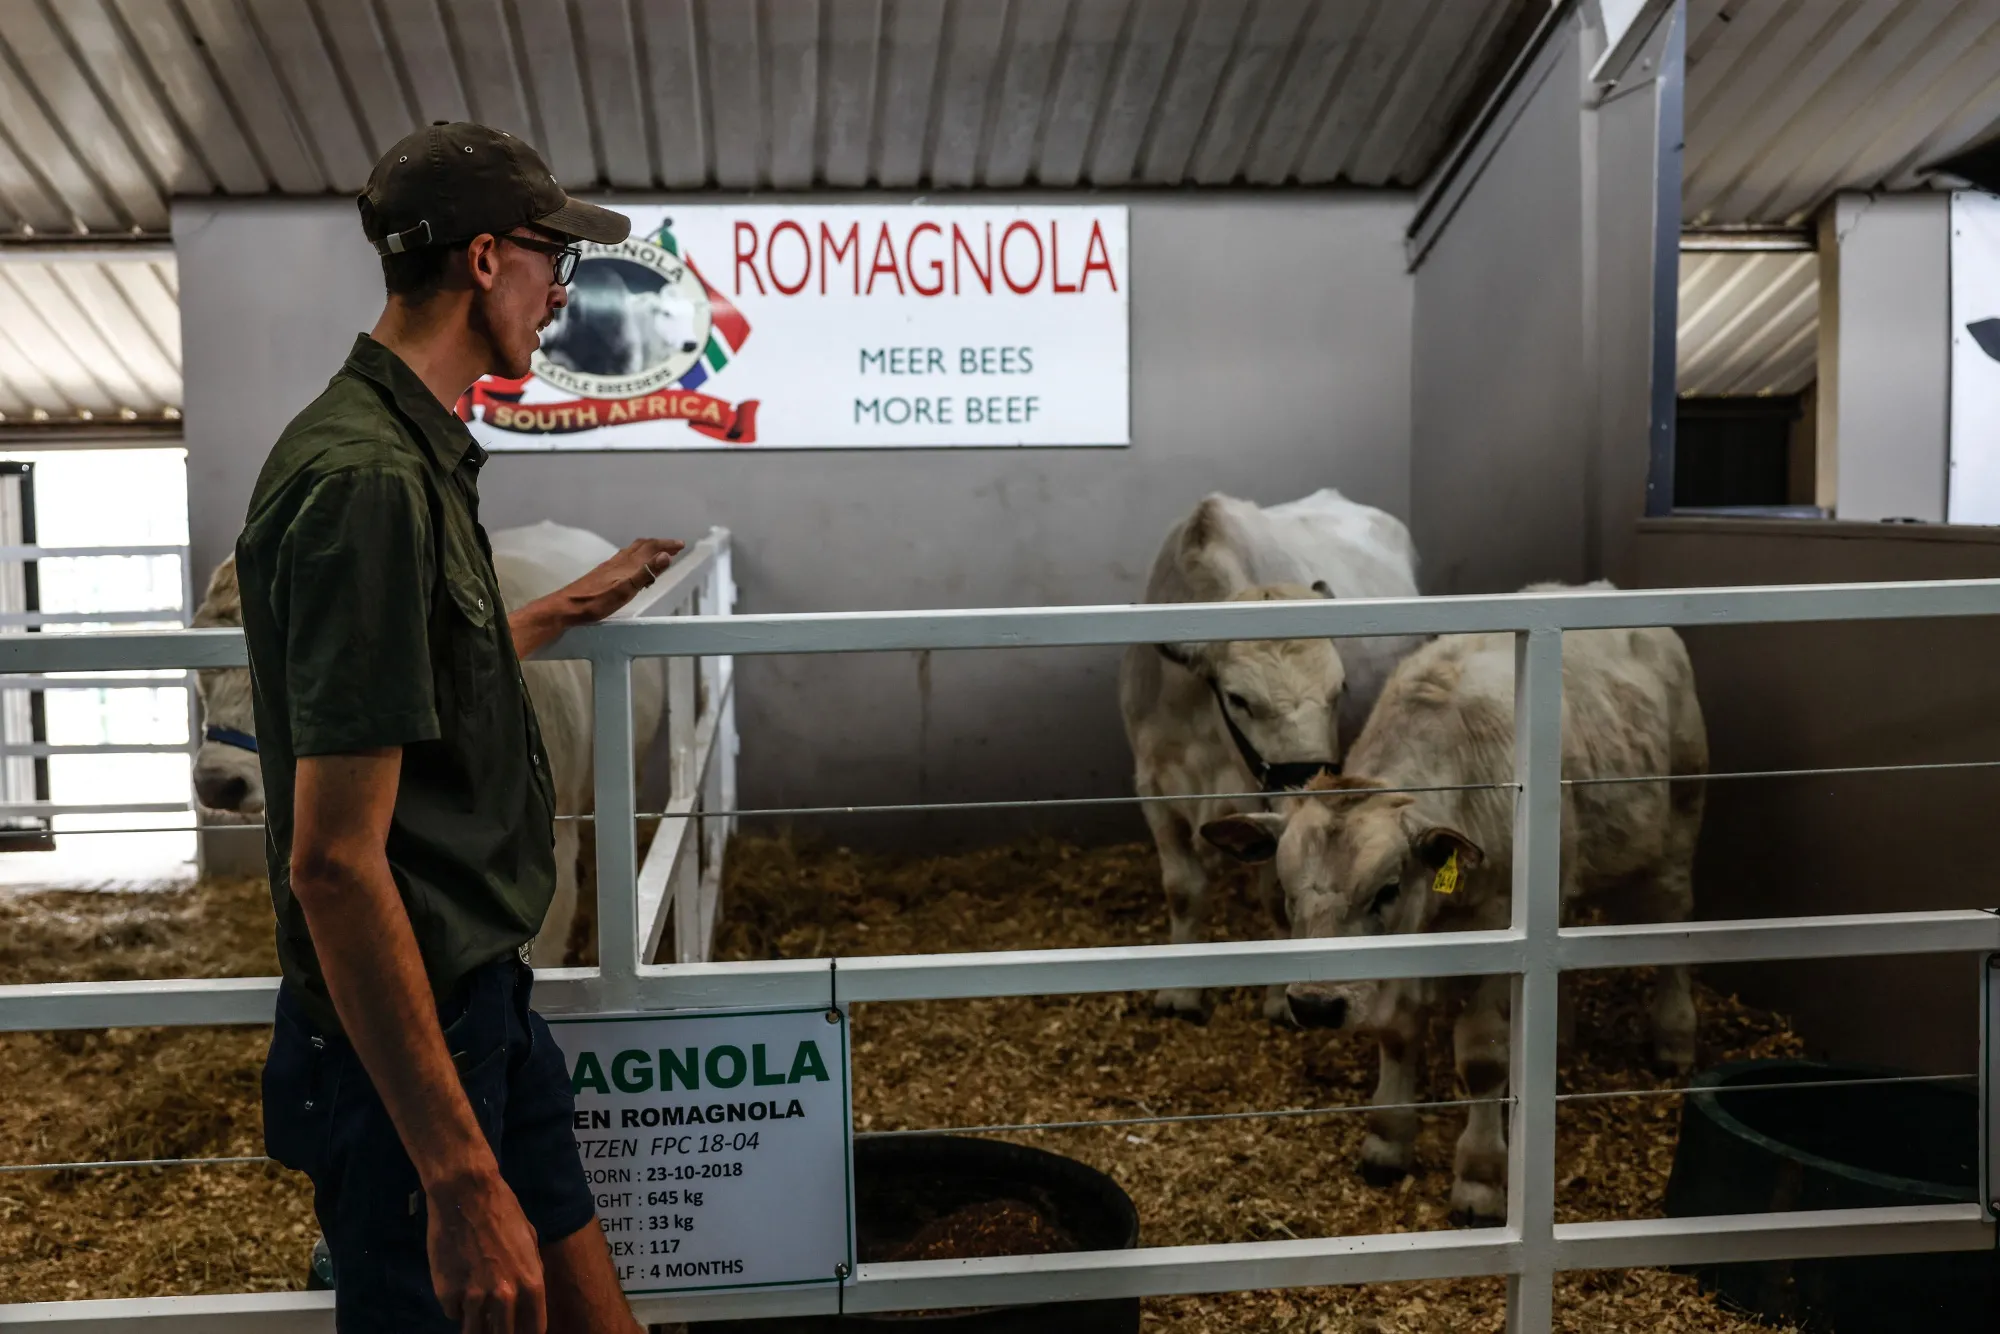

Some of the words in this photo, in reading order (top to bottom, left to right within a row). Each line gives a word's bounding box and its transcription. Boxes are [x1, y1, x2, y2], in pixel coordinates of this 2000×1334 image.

[734, 218, 1118, 297] ROMAGNOLA
[860, 347, 946, 375] MEER
[959, 346, 1033, 374] BEES
[538, 361, 589, 392] CATTLE
[598, 367, 672, 393] BREEDERS
[494, 405, 597, 431] SOUTH
[607, 395, 721, 423] AFRICA
[854, 398, 952, 425] MORE
[966, 396, 1038, 424] BEEF
[620, 1099, 806, 1129] ROMAGNOLA
[576, 1138, 638, 1159] TZEN
[650, 1135, 692, 1156] FPC
[697, 1131, 760, 1154] 18-04
[646, 1162, 743, 1182] 23-10-2018
[647, 1190, 679, 1206] 645
[683, 1188, 704, 1207] kg
[648, 1215, 670, 1230] 33
[673, 1213, 694, 1232] kg
[649, 1238, 681, 1255] 117
[649, 1264, 661, 1279] 4
[665, 1258, 744, 1278] MONTHS
